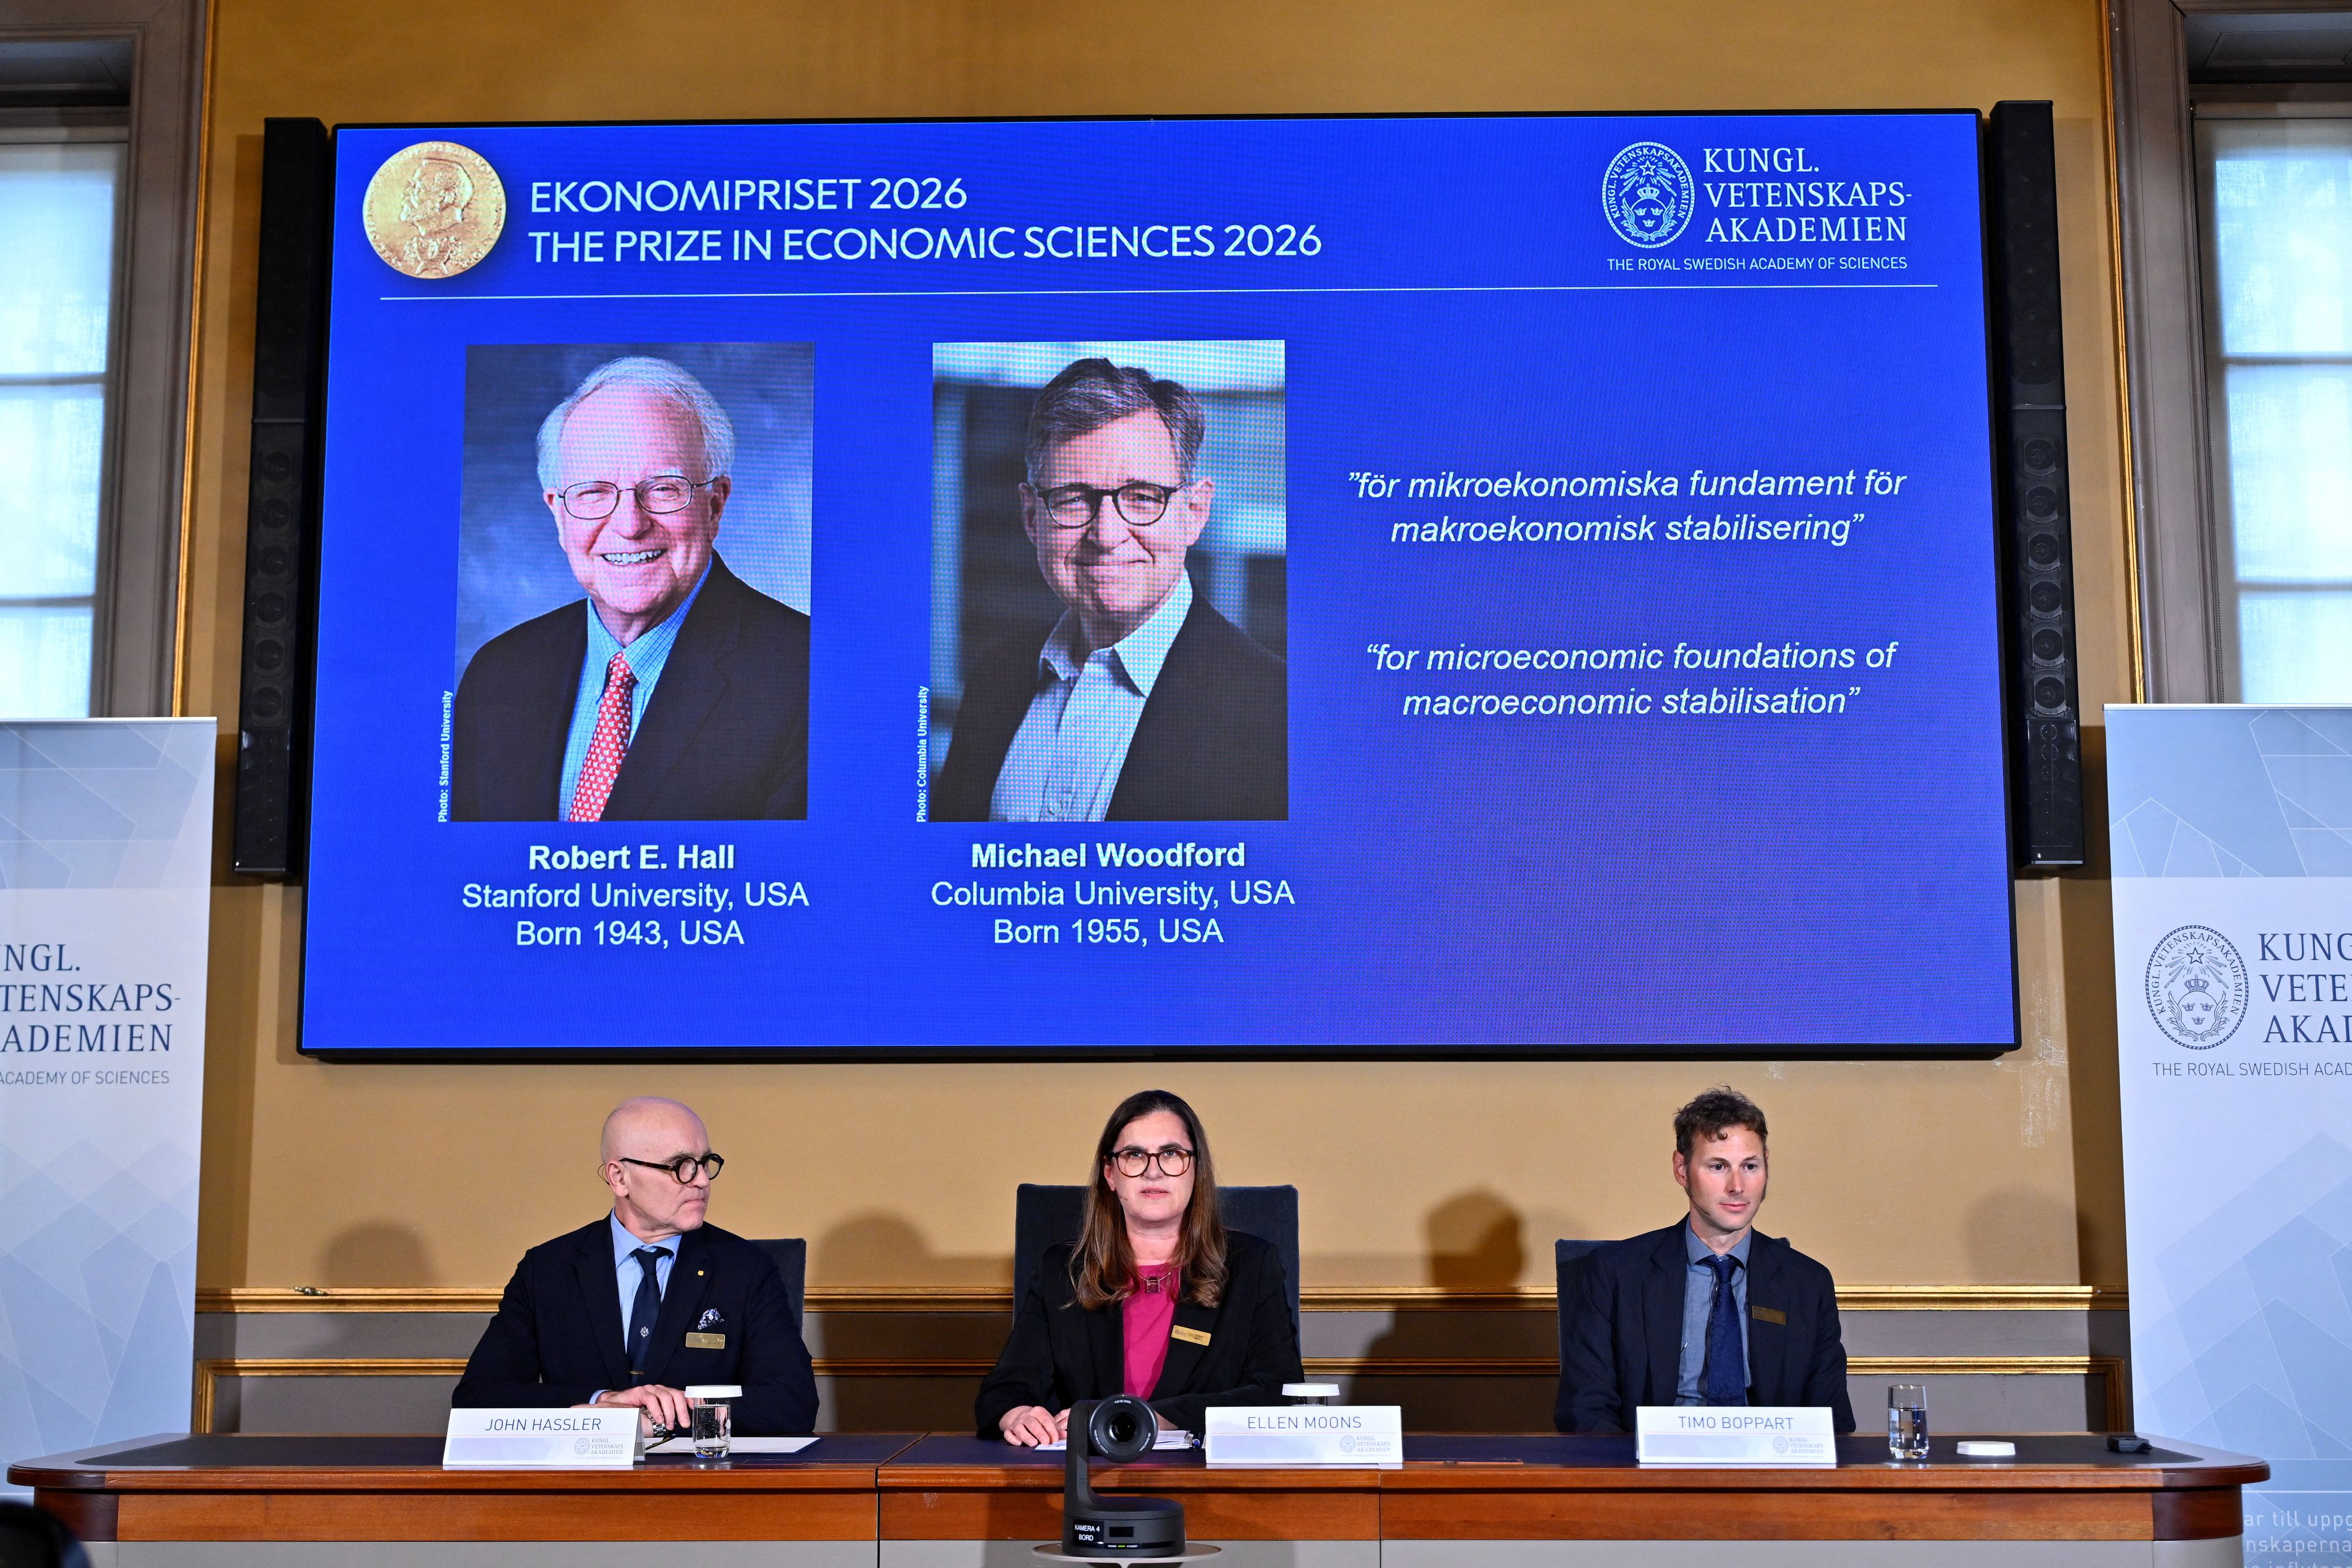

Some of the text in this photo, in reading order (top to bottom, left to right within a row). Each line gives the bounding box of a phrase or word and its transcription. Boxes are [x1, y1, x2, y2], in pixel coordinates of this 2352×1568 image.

[1703, 147, 1819, 173] KUNGL.
[531, 177, 967, 213] EKONOMIPRISET 2026
[1607, 147, 1689, 219] KUNGL. VETENSKAPSAKADEMIEN
[1703, 182, 1912, 208] VETENSKAPS-
[1705, 216, 1907, 242] AKADEMIEN
[528, 224, 1322, 263] THE PRIZE IN ECONOMIC SCIENCES 2026
[1607, 256, 1907, 270] THE ROYAL SWEDISH ACADEMY OF SCIENCES
[1348, 469, 1908, 498] ”för mikroekonomiska fundament för
[1391, 513, 1865, 547] makroekonomisk stabilisering”
[1367, 641, 1899, 671] “for microeconomic foundations of
[1402, 686, 1861, 716] macroeconomic stabilisation”
[437, 690, 453, 823] Photo: Stanford University
[916, 686, 930, 823] Photo: Columbia University
[529, 844, 734, 870] Robert E. Hall
[972, 842, 1245, 868] Michael Woodford
[462, 881, 810, 913] Stanford University, USA
[931, 880, 1296, 911] Columbia University, USA
[516, 920, 745, 950] Born 1943, USA
[994, 918, 1225, 947] Born 1955, USA
[0, 944, 81, 971] NGL.
[2151, 931, 2243, 1015] KUNGL. VETENSKAPSAKADEMIEN
[0, 1024, 172, 1052] ADEMIEN
[71, 1071, 91, 1085] OF
[95, 1070, 169, 1085] SCIENCES
[2152, 1062, 2183, 1076] THE
[2187, 1062, 2235, 1076] ROYAL
[2239, 1062, 2308, 1076] SWEDISH
[485, 1418, 602, 1431] JOHN HASSLER
[1248, 1416, 1361, 1429] ELLEN MOONS
[1678, 1416, 1793, 1429] TIMO BOPPART
[1074, 1524, 1095, 1532] KAMERA
[2271, 1510, 2300, 1526] till
